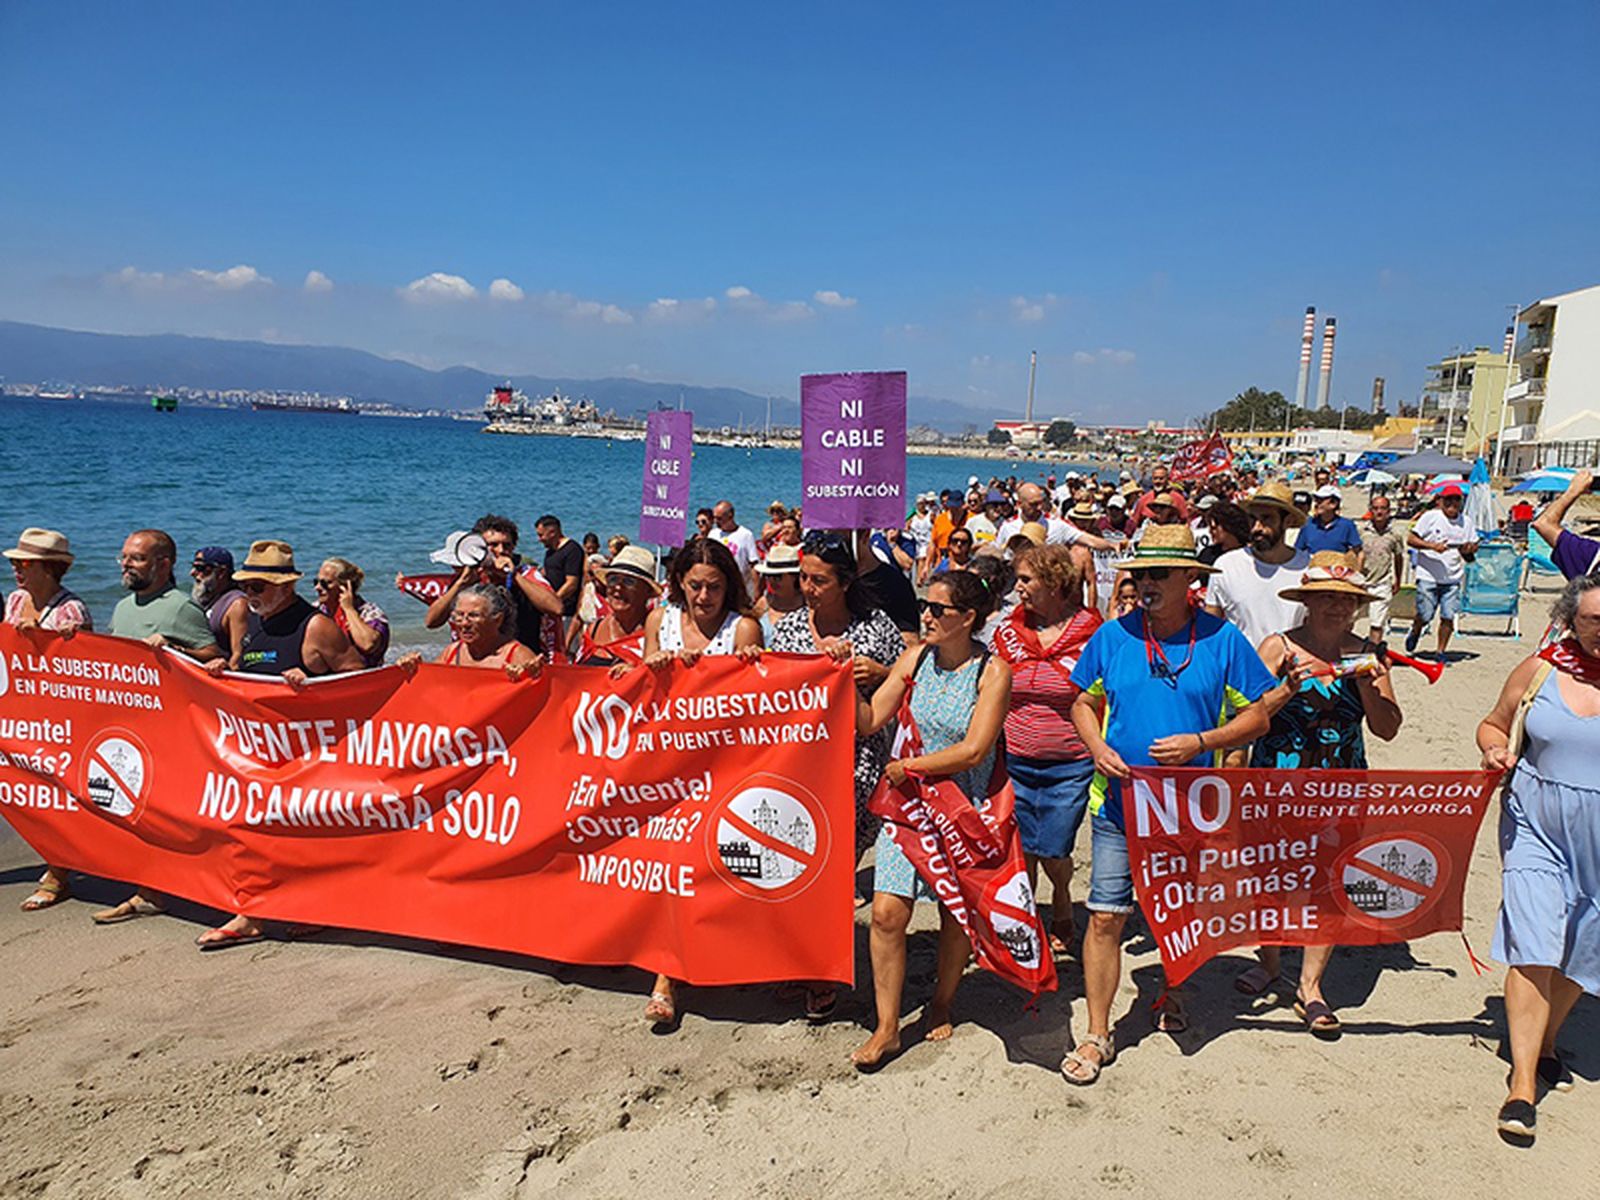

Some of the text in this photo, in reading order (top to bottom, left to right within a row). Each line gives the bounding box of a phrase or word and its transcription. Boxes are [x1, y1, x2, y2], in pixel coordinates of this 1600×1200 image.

[841, 400, 863, 418] NI
[660, 435, 671, 450] NI
[821, 429, 884, 448] CABLE
[651, 459, 680, 476] CABLE
[841, 459, 863, 476] NI
[656, 484, 668, 500] NI
[806, 483, 900, 498] SUBESTACIÓN
[11, 654, 161, 686] A LA SUBESTACIÓN
[15, 678, 163, 711] EN PUENTE MAYORGA
[572, 682, 829, 760] NO A LA SUBESTACIÓN
[634, 722, 830, 752] EN PUENTE MAYORGA
[214, 708, 518, 778] PUENTE MAYORGA,
[10, 747, 73, 778] más?
[565, 771, 713, 812] ¡En Puente!
[1132, 774, 1484, 838] NO A LA SUBESTACIÓN
[198, 771, 522, 846] NO CAMINARÁ SOLO
[1241, 802, 1474, 821] EN PUENTE MAYORGA
[565, 808, 702, 844] ¿Otra más?
[578, 854, 695, 897] IMPOSIBLE
[1141, 835, 1319, 888] ¡En Puente!
[1153, 864, 1317, 924] ¿Otra más?
[1163, 905, 1319, 962] IMPOSIBLE
